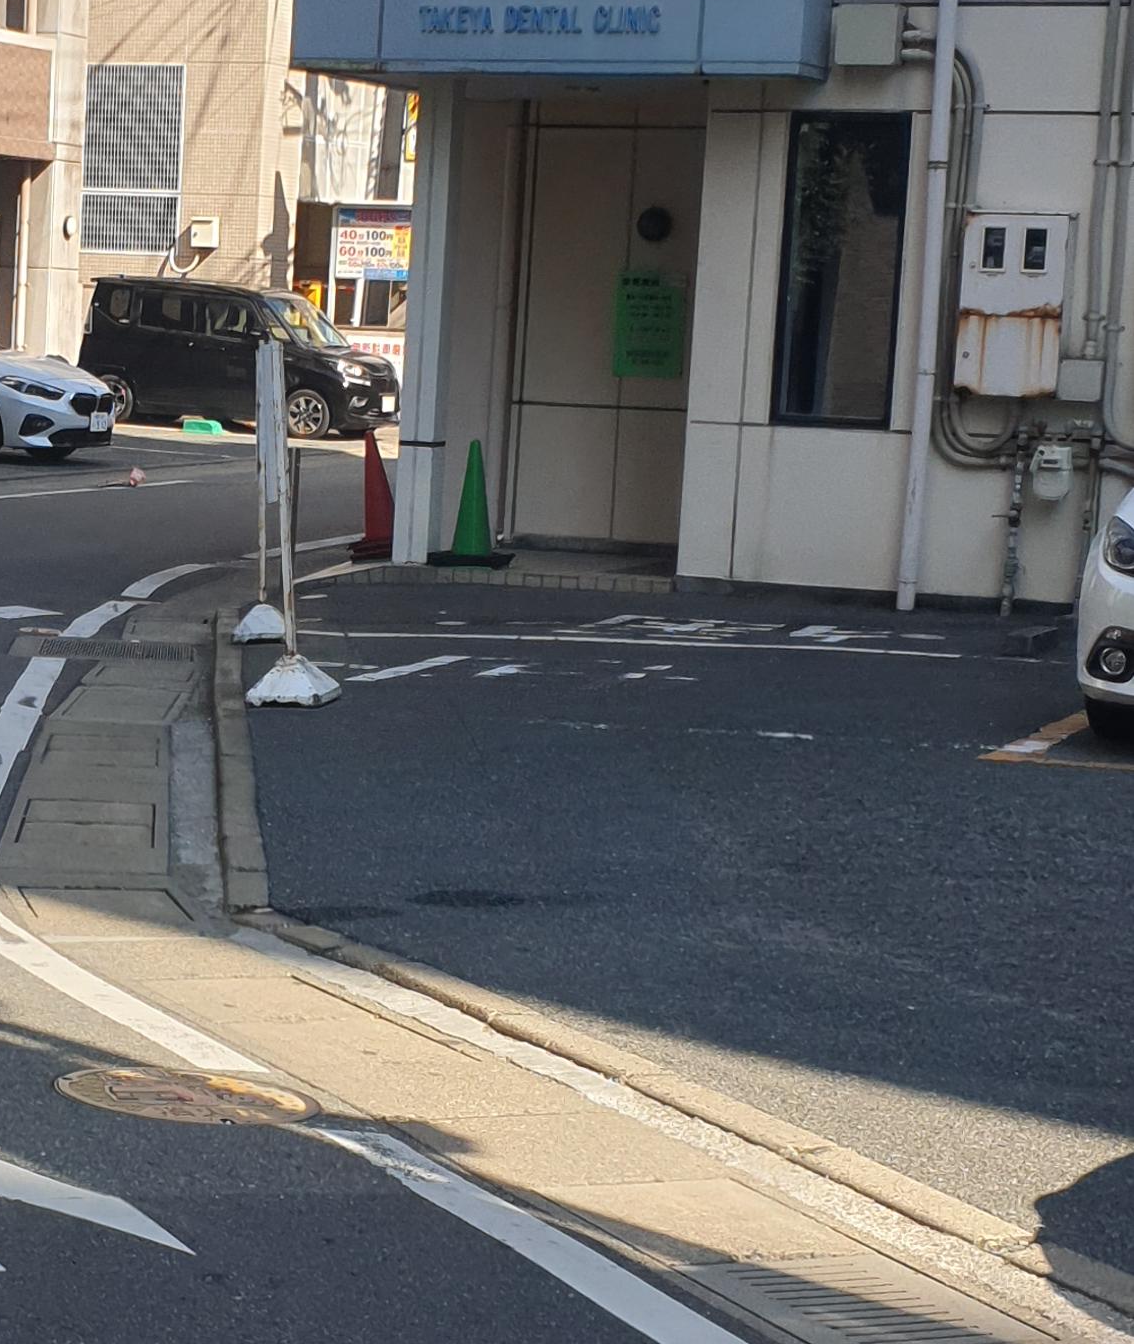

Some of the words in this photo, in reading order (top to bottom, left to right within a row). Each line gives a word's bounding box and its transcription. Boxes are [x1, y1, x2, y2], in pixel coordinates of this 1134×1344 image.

[419, 6, 494, 35] TAKEYA
[503, 6, 583, 35] DENTAL
[593, 6, 662, 35] CLINIC
